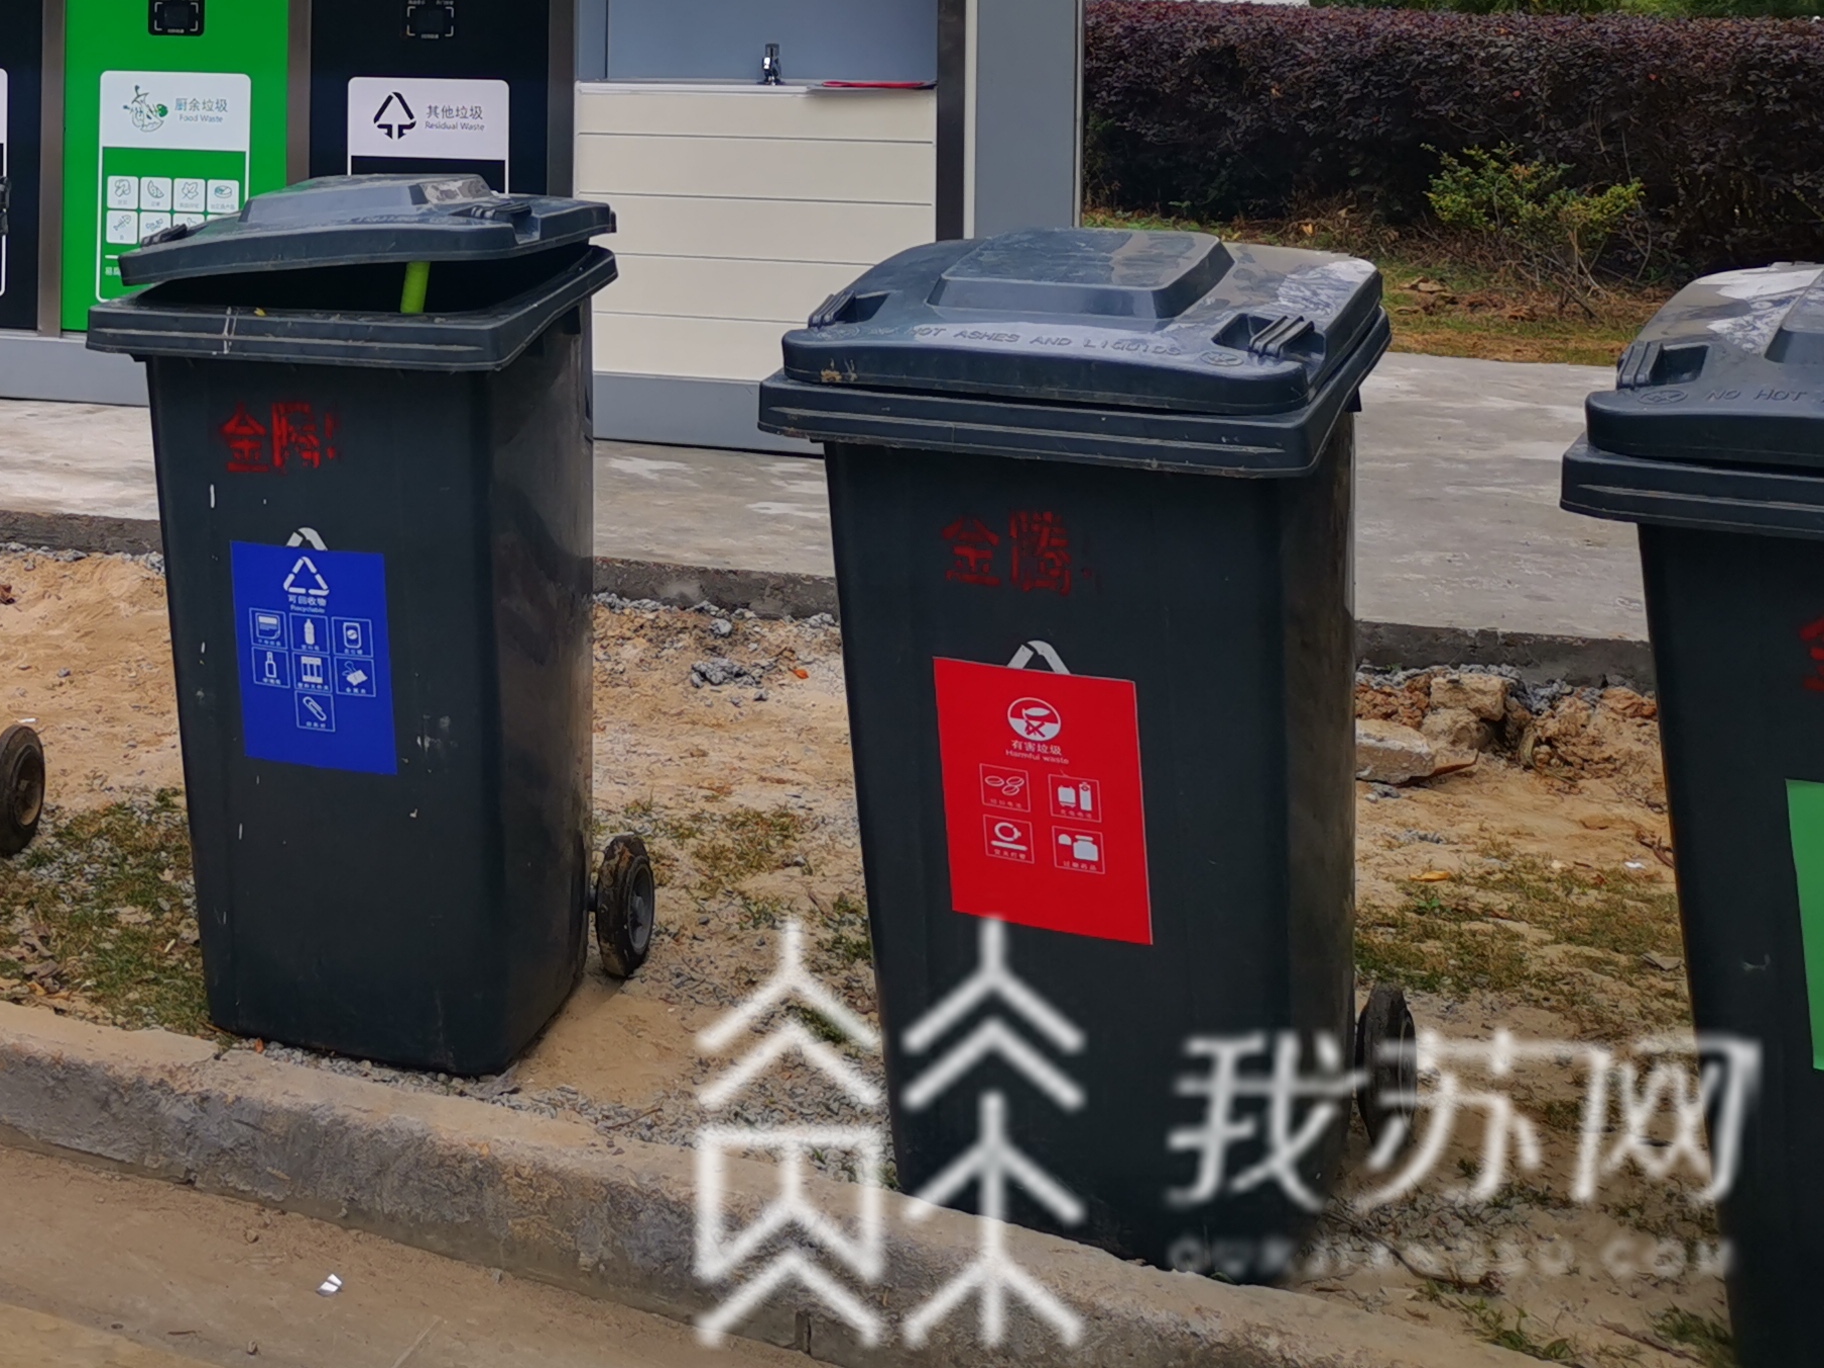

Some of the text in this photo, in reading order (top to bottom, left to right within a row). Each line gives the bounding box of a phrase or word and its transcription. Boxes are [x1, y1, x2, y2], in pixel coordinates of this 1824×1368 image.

[175, 98, 228, 112] 厨余垃圾
[179, 114, 223, 123] Food Waste
[426, 105, 483, 120] 其他垃圾
[425, 121, 485, 131] Residual Waste
[953, 330, 1021, 343] ASHES
[1029, 335, 1073, 346] AND
[1083, 338, 1182, 356] LIQUIDS
[1705, 389, 1808, 402] NO HOT
[288, 594, 327, 607] 可回收物
[1011, 740, 1062, 756] 有害垃圾
[1005, 749, 1041, 761] Harmful
